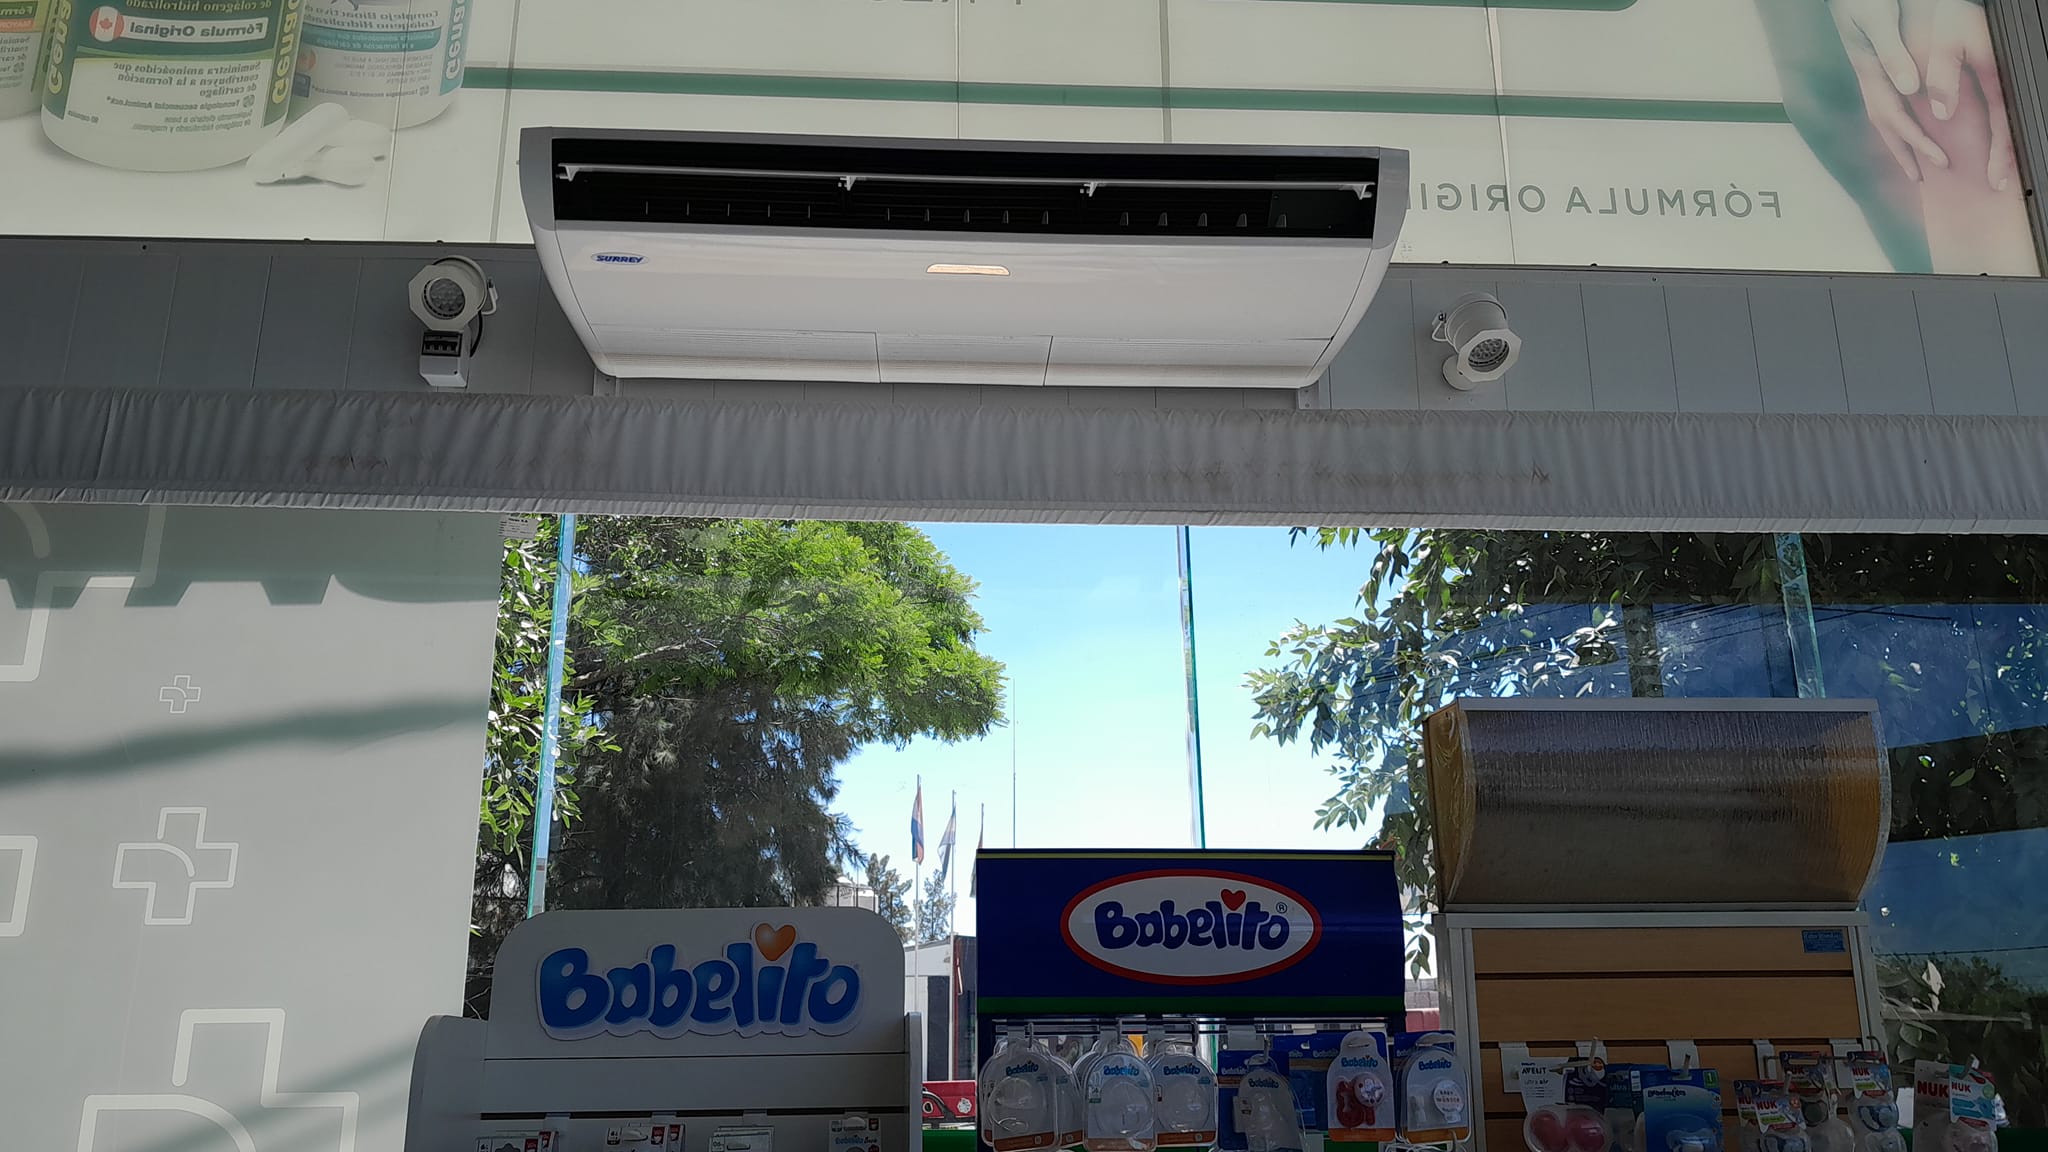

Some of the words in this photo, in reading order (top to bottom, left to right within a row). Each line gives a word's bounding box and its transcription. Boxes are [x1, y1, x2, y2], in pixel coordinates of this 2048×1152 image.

[596, 255, 645, 263] SURREY
[1094, 888, 1290, 950] Babelito
[538, 922, 861, 1029] Babelito
[1341, 1055, 1378, 1068] Babelito
[1852, 1067, 1870, 1076] NUK
[1917, 1080, 1949, 1098] NUK
[1952, 1082, 1971, 1093] NUK
[1738, 1096, 1751, 1104] NU
[1756, 1100, 1777, 1110] NUK
